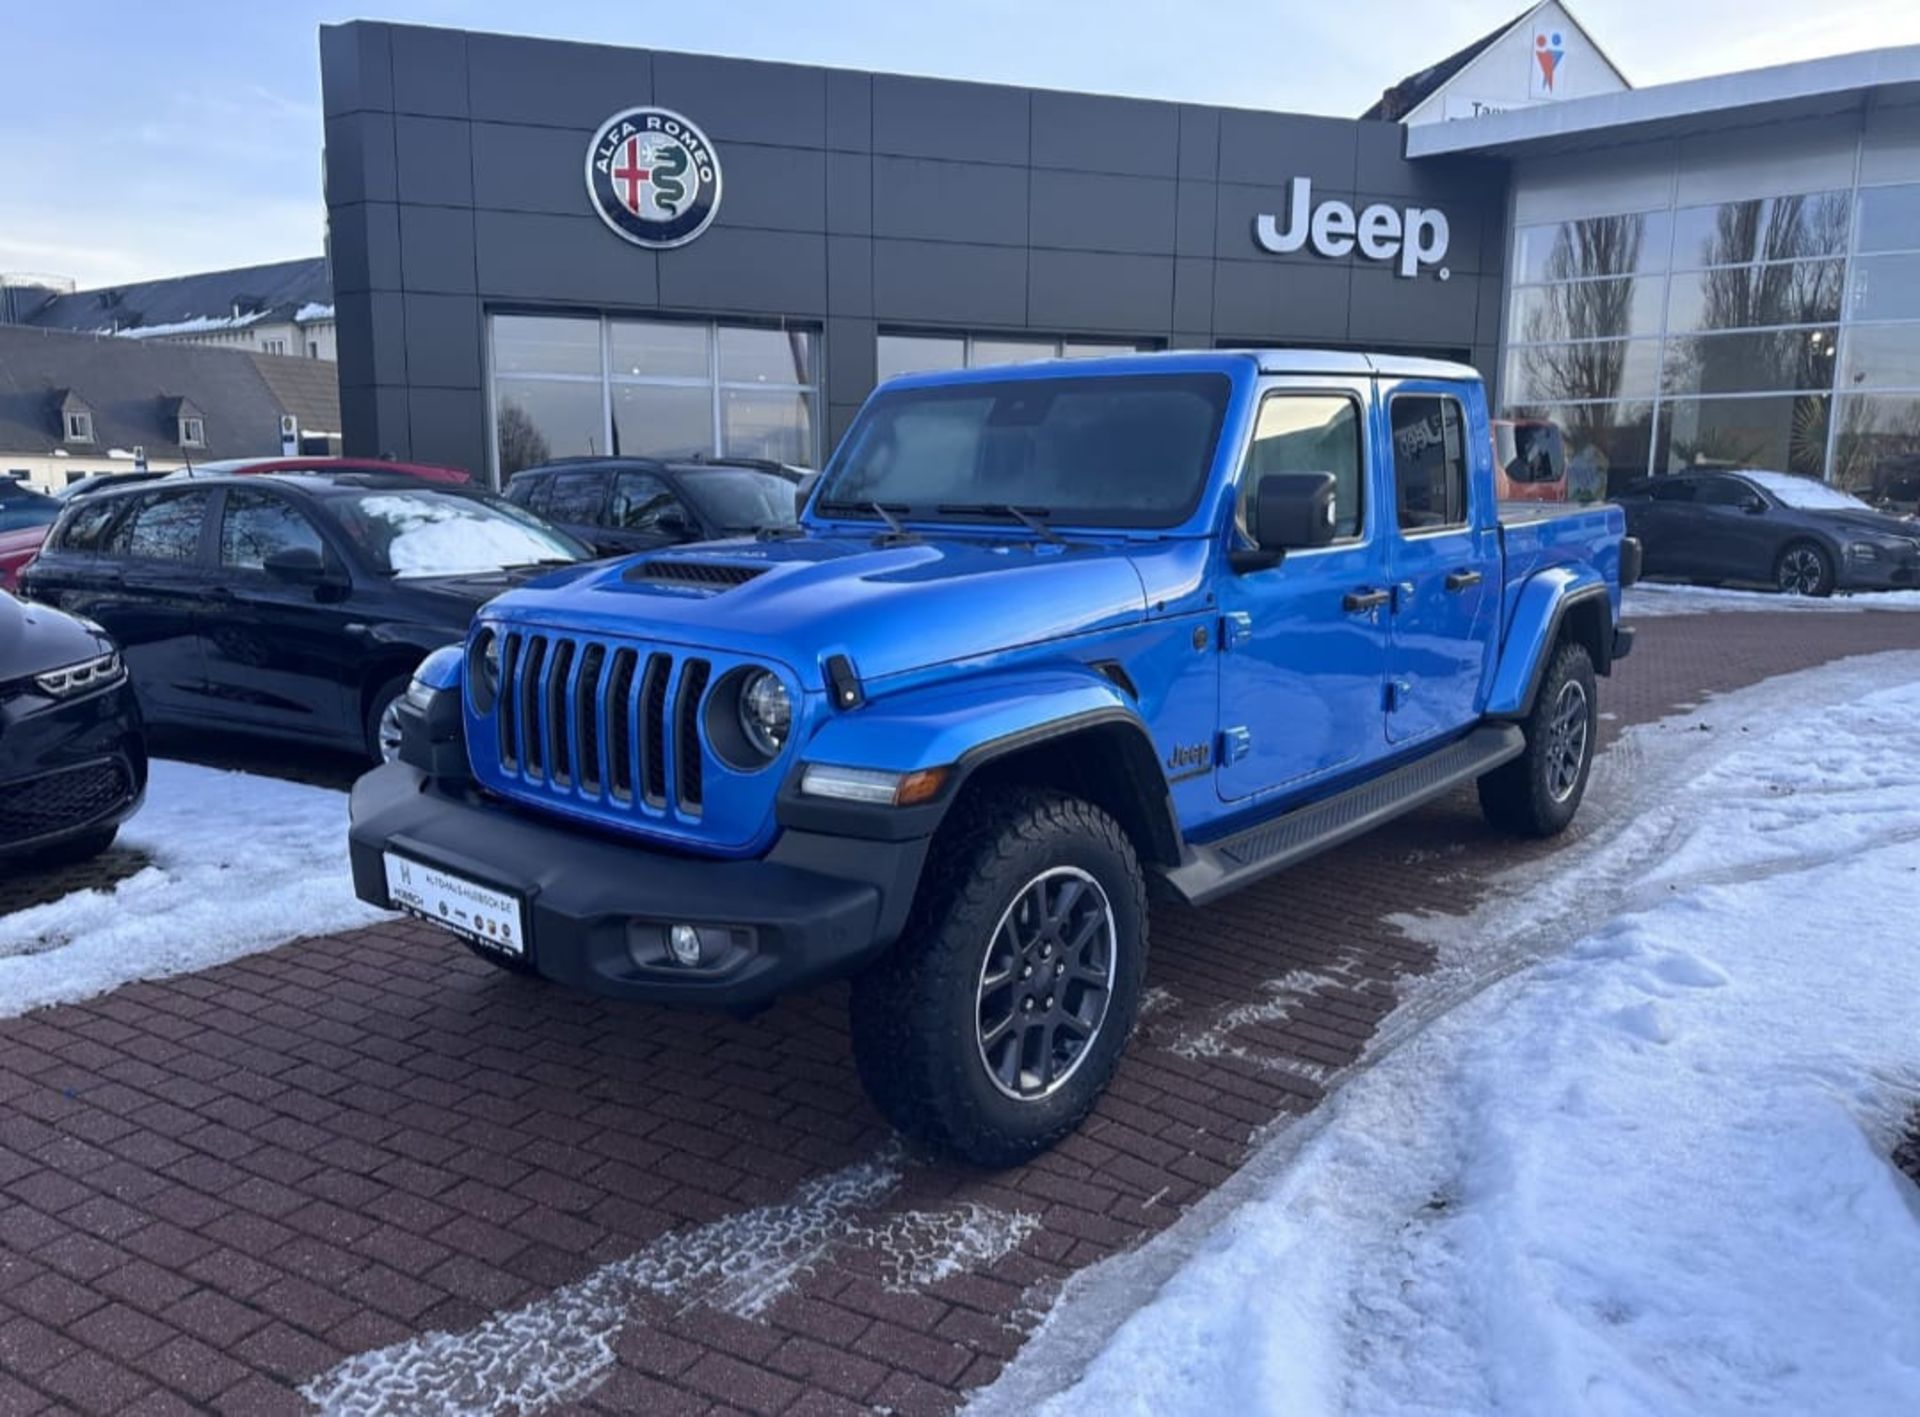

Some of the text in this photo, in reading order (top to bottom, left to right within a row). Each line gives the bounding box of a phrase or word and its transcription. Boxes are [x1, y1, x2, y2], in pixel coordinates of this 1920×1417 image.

[596, 116, 713, 183] ALFA ROMEO
[1257, 176, 1450, 277] Jeep
[1167, 741, 1212, 769] Jeep
